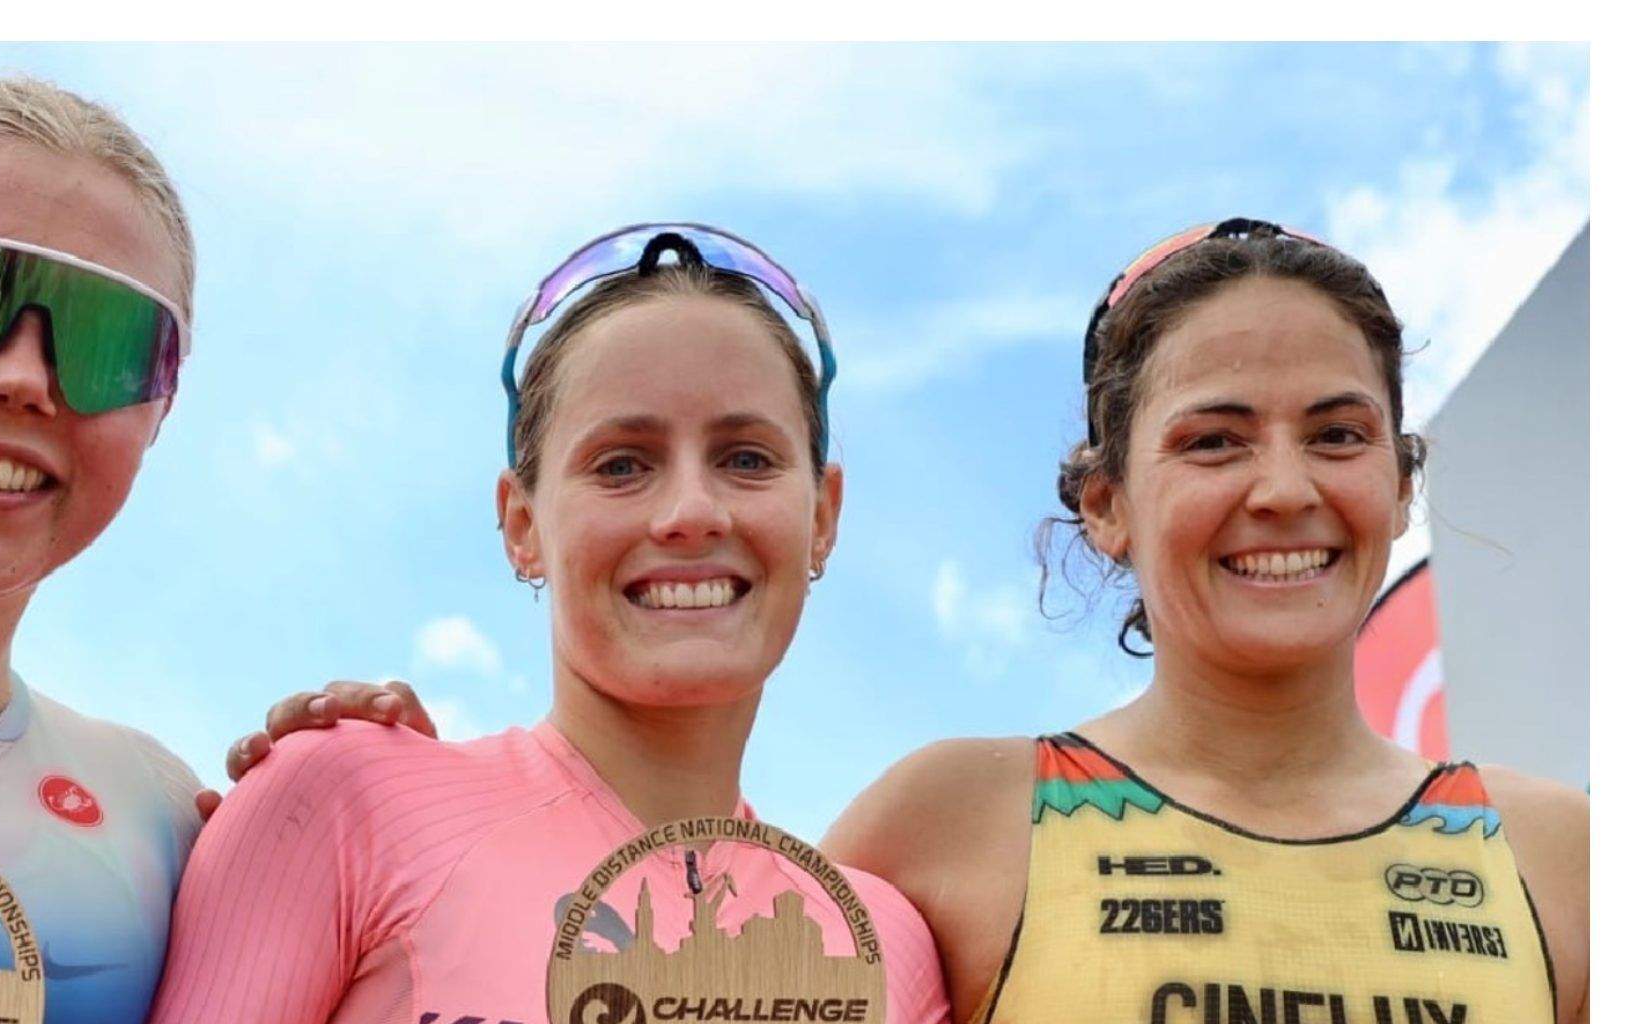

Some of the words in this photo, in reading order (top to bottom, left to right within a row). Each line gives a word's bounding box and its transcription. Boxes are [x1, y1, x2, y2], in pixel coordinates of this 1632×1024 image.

[556, 888, 596, 961] MIDDLE
[594, 823, 677, 887] DISTANCE
[679, 817, 772, 846] NATIONAL
[777, 834, 882, 966] CHAMPIONSHIPS
[1392, 871, 1477, 898] PTO
[1099, 898, 1224, 934] 226ERS
[651, 996, 869, 1023] CHALLENGE
